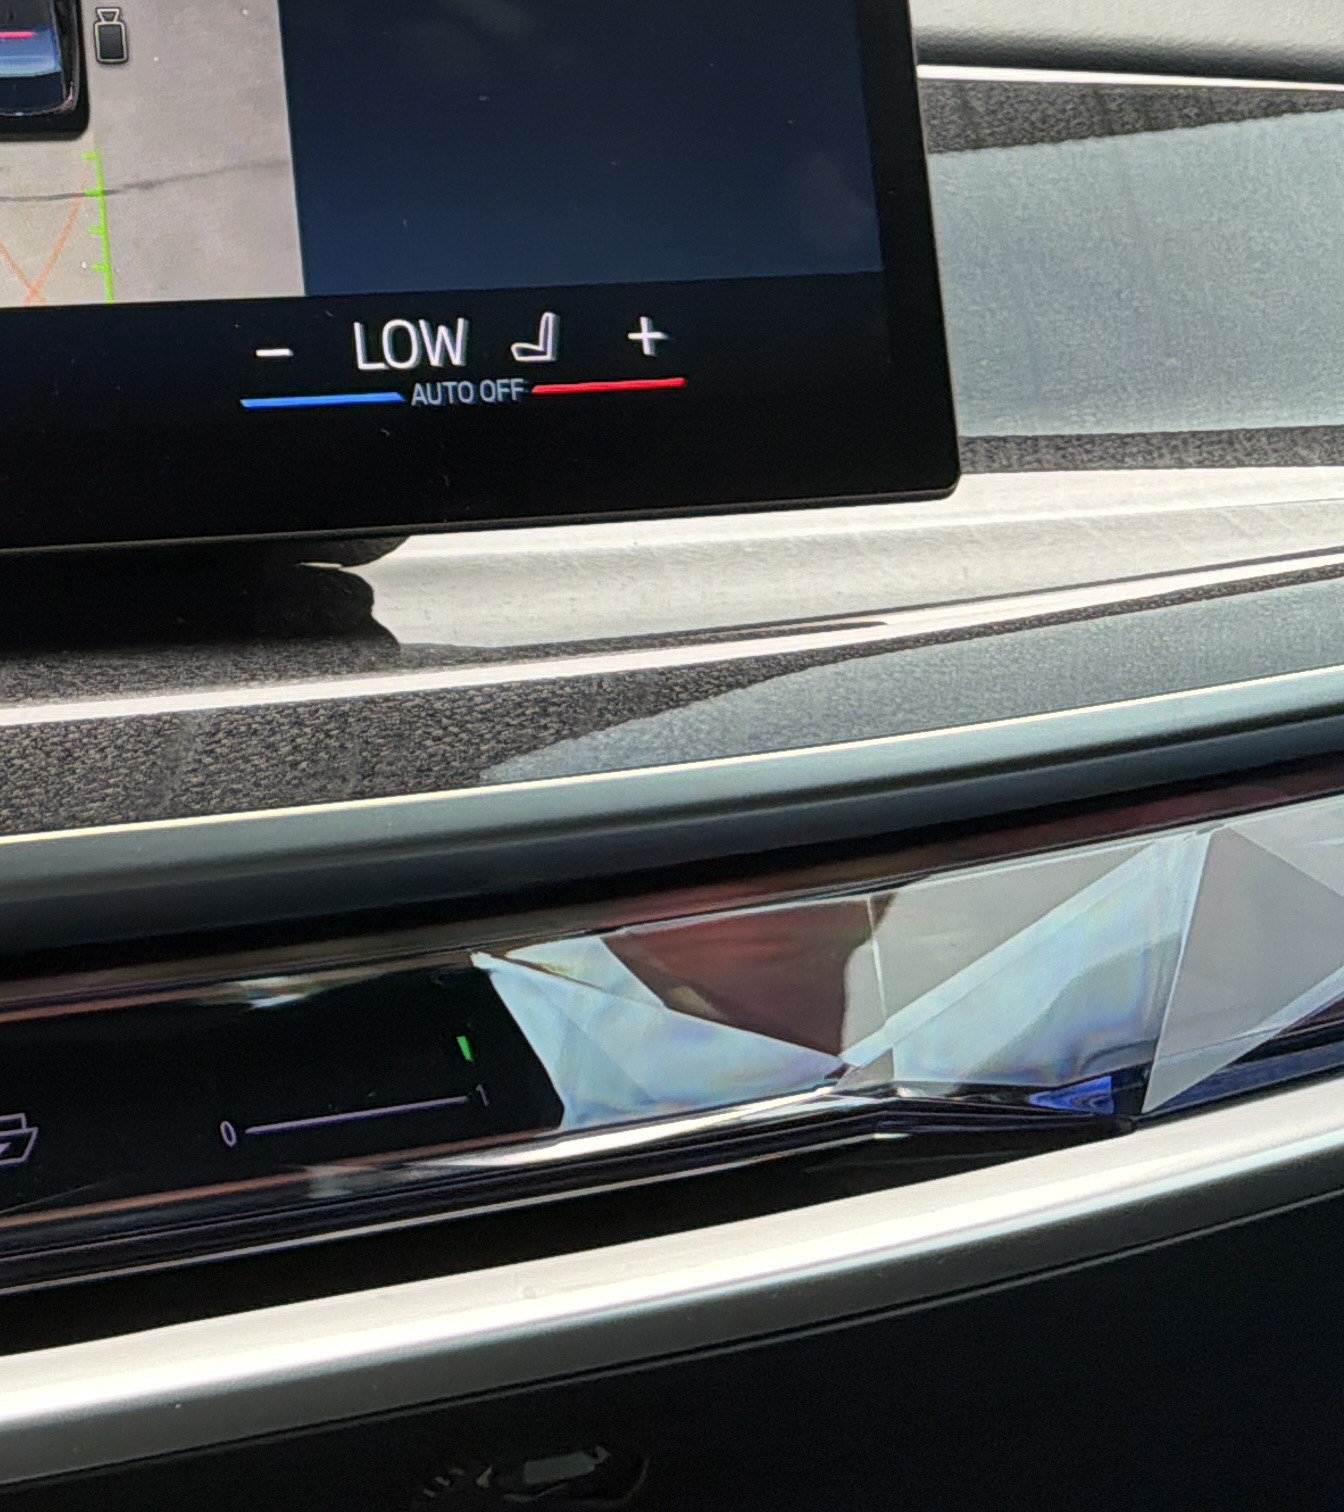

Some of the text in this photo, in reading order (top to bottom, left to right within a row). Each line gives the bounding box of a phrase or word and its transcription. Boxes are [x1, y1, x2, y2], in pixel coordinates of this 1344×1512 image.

[353, 317, 468, 370] LOW
[411, 379, 525, 407] AUTO OFF
